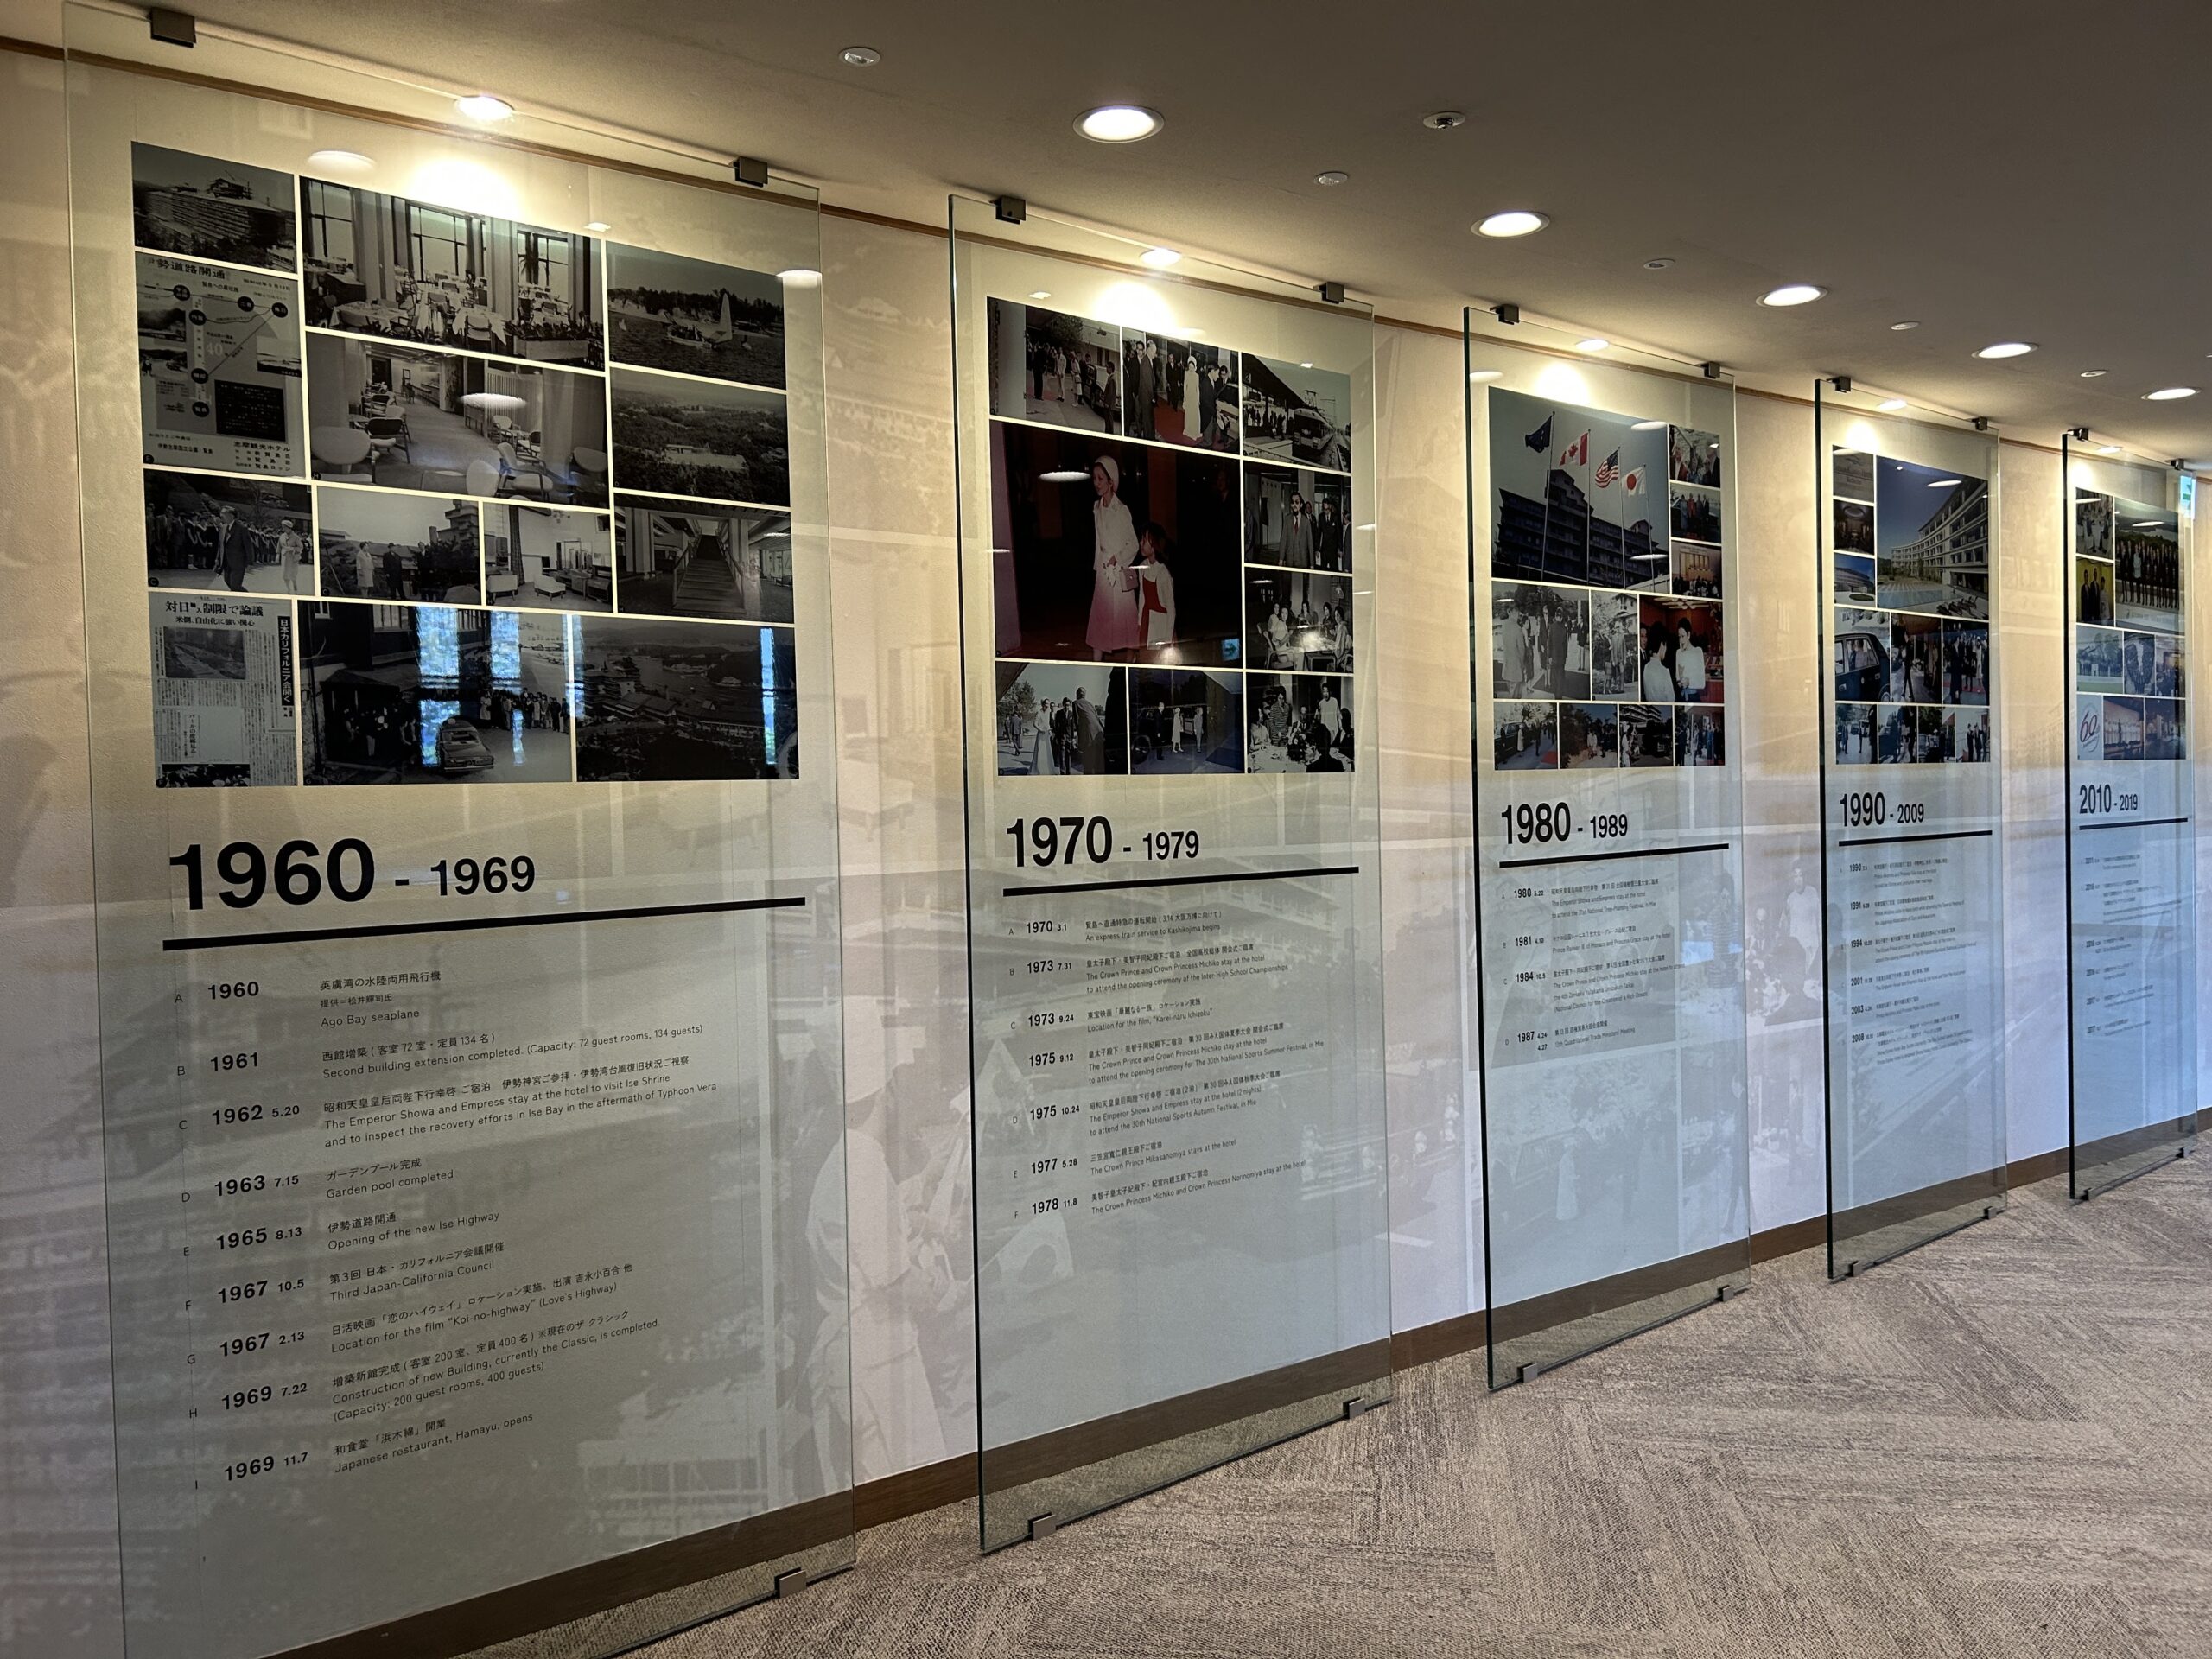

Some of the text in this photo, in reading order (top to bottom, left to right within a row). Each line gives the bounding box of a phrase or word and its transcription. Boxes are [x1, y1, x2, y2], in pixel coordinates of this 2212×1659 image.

[1840, 792, 1924, 826] 1990 2009
[2080, 785, 2138, 814] 2010 2019
[1502, 802, 1627, 844] 1980 1989
[1007, 816, 1112, 867] 1970
[1143, 831, 1198, 860] 1979
[169, 838, 374, 910] 1960
[431, 856, 535, 896] 1969
[1515, 888, 1531, 898] 1980
[1027, 921, 1052, 933] 1970
[1516, 937, 1531, 946] 1981
[1027, 960, 1053, 973] 1973
[1516, 972, 1533, 982] 1984
[208, 982, 258, 999] 1960
[320, 970, 441, 991] 英虞湾の水陸両用飛行機
[175, 994, 183, 1003] A
[321, 1010, 420, 1028] Ago Bay seaplane
[1029, 1013, 1054, 1027] 1973
[1518, 1032, 1534, 1042] 1987
[211, 1052, 257, 1071] 1961
[322, 1024, 702, 1078] Second building extension completed. (Capacity: 72 guest rooms, 134 guests)
[1030, 1052, 1055, 1066] 1975
[178, 1066, 185, 1076] B
[324, 1120, 345, 1129] The
[349, 1114, 397, 1126] Emperor
[400, 1108, 435, 1119] Showa
[438, 1103, 458, 1114] and
[461, 1098, 505, 1110] Empress
[507, 1096, 529, 1104] stay
[531, 1092, 543, 1101] at
[545, 1090, 562, 1098] the
[564, 1084, 588, 1096] hotel
[603, 1081, 623, 1090] visit
[641, 1075, 671, 1085] Shrine
[1031, 1105, 1056, 1120] 1975
[179, 1120, 187, 1129] C
[213, 1105, 299, 1125] 1962 5.20
[324, 1135, 346, 1147] and
[365, 1128, 405, 1141] inspect
[409, 1125, 426, 1135] the
[429, 1119, 474, 1131] recovery
[477, 1113, 513, 1124] efforts
[528, 1109, 543, 1117] Ise
[545, 1106, 563, 1115] Bay
[578, 1101, 594, 1109] the
[596, 1093, 642, 1107] aftermath
[645, 1090, 654, 1100] of
[657, 1087, 695, 1099] Typhoon
[1032, 1159, 1057, 1173] 1977
[1103, 1162, 1124, 1173] Crown
[1124, 1159, 1144, 1167] Prince
[1222, 1139, 1236, 1147] hotel
[326, 1157, 422, 1181] ガーデンプール完成
[215, 1175, 298, 1196] 1963 7.15
[326, 1169, 454, 1198] Garden pool completed
[182, 1192, 190, 1202] D
[1033, 1198, 1058, 1214] 1978
[327, 1211, 397, 1234] 伊勢道路開通
[327, 1213, 499, 1250] Opening of the new Ise Highway
[217, 1227, 302, 1249] 1965 8.13
[184, 1247, 189, 1256] E
[329, 1260, 494, 1300] Third Japan-California Council
[219, 1279, 304, 1303] 1967 10.5
[186, 1300, 191, 1310] F
[331, 1336, 380, 1353] Location
[383, 1332, 400, 1341] for
[404, 1326, 421, 1337] the
[424, 1321, 444, 1332] film
[539, 1293, 573, 1307] (Love's
[575, 1281, 617, 1298] Highway)
[220, 1332, 304, 1357] 1967 2.13
[188, 1355, 195, 1364] G
[332, 1381, 404, 1403] Construction
[407, 1374, 420, 1385] of
[423, 1371, 444, 1382] new
[447, 1361, 492, 1376] Building,
[494, 1347, 539, 1364] currently
[542, 1344, 558, 1353] the
[561, 1335, 597, 1349] Classic,
[222, 1383, 307, 1409] 1969 7.22
[189, 1408, 197, 1418] H
[334, 1414, 533, 1472] Japanese restaurant, Hamayu, opens
[225, 1452, 308, 1480] 1969 11.7
